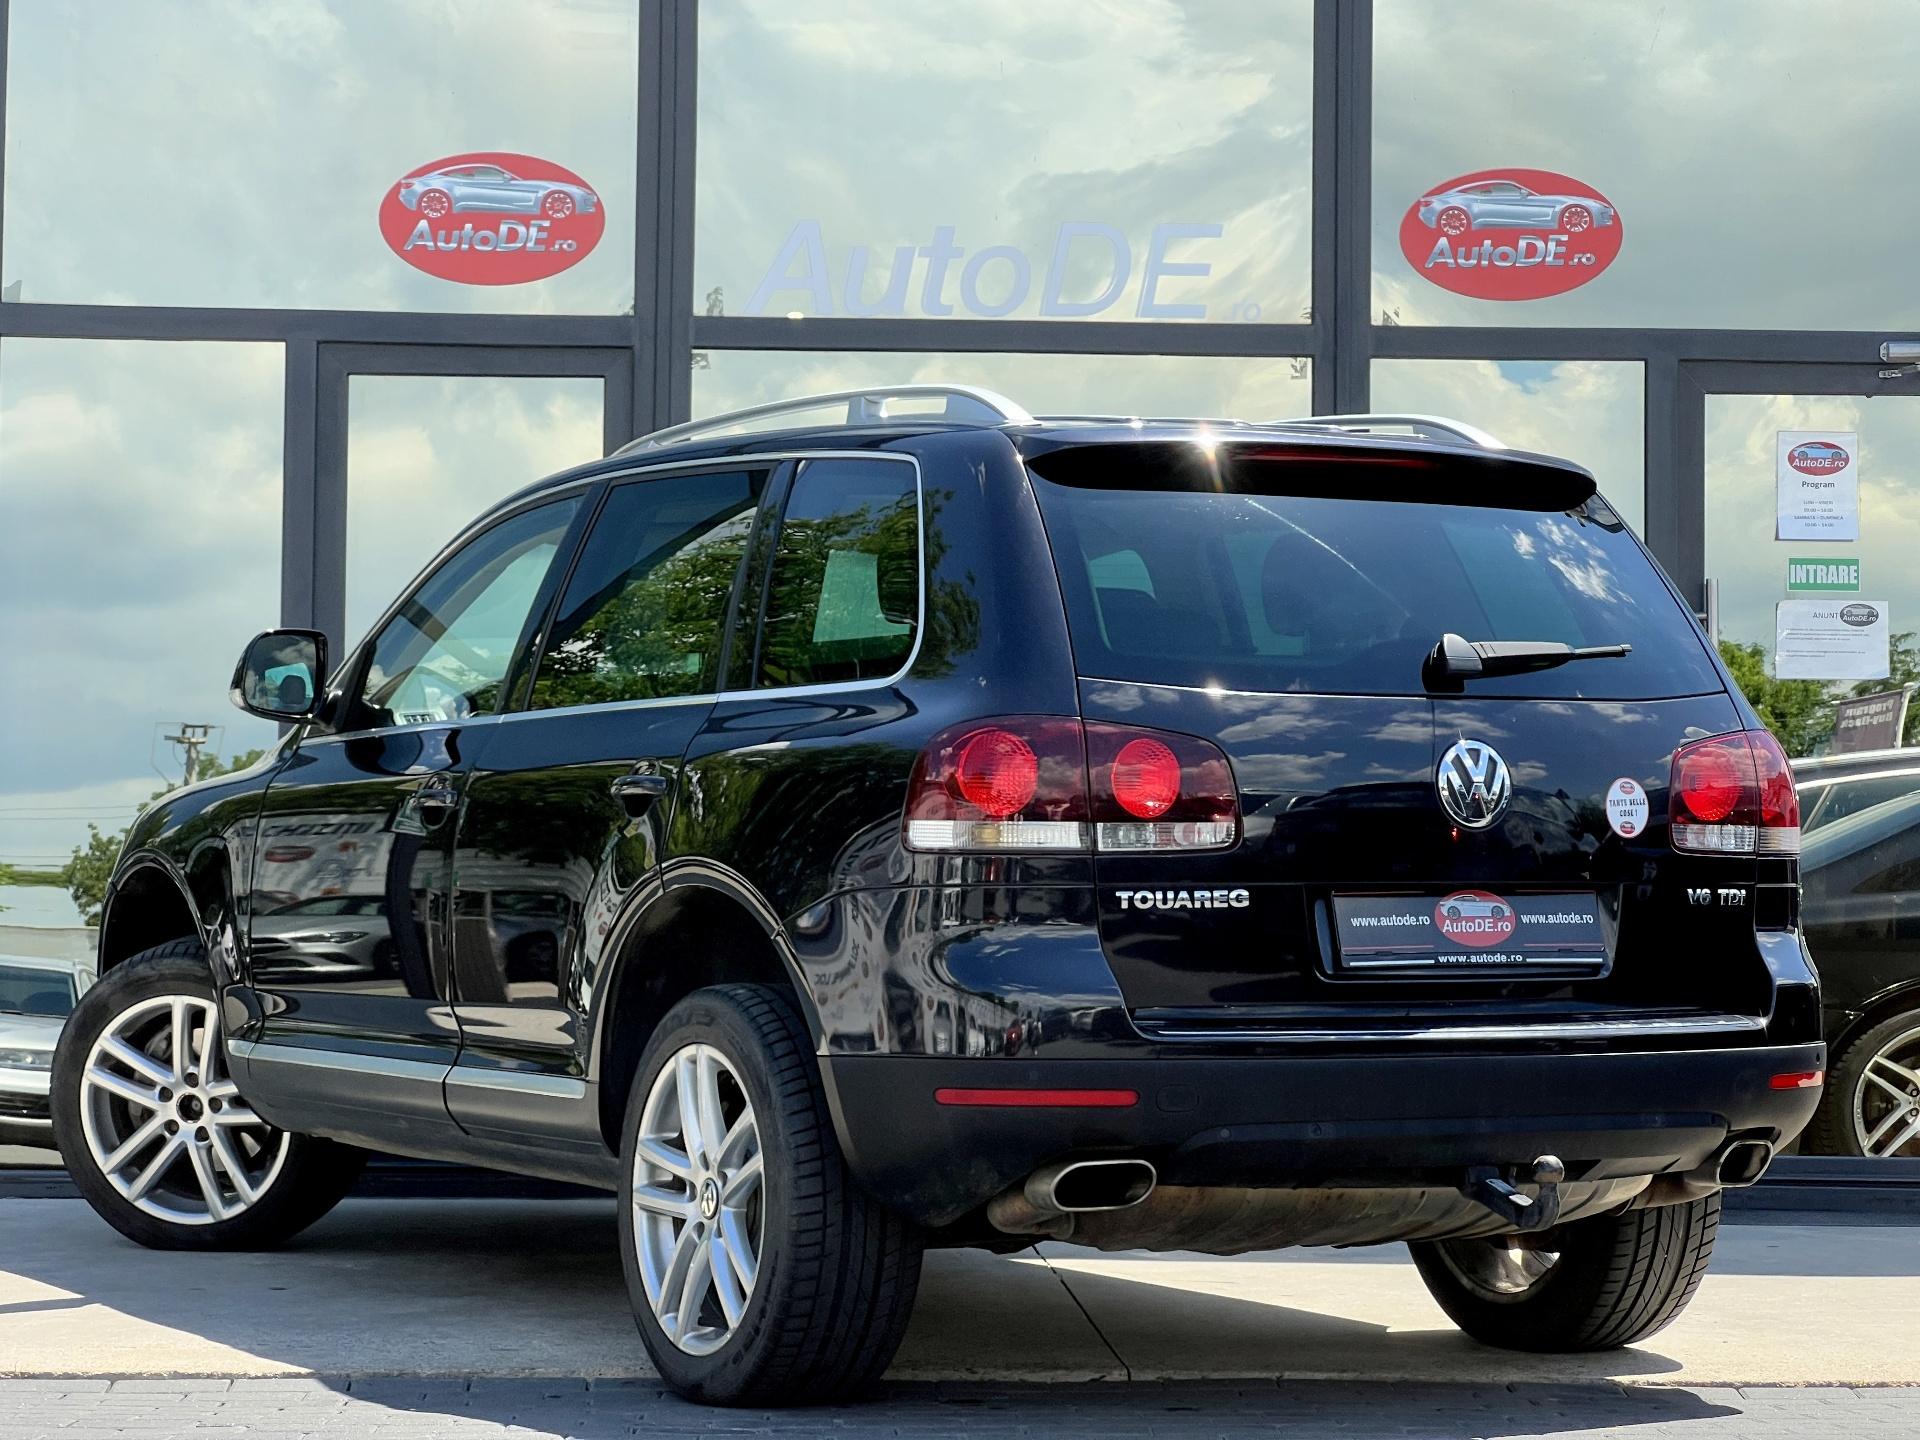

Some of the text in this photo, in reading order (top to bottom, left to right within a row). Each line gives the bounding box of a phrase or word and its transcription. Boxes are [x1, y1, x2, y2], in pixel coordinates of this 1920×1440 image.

[1792, 458, 1846, 468] AutoDE.ro
[1801, 480, 1835, 489] Program
[1789, 564, 1858, 584] INTRARE
[1115, 888, 1250, 910] TOUAREG
[1686, 888, 1711, 905] V6
[1350, 913, 1431, 927] www.autode.ro
[1520, 912, 1594, 924] www.autode.ro
[1442, 919, 1512, 933] AutoDE.ro
[1438, 952, 1523, 963] www.autode.ro
